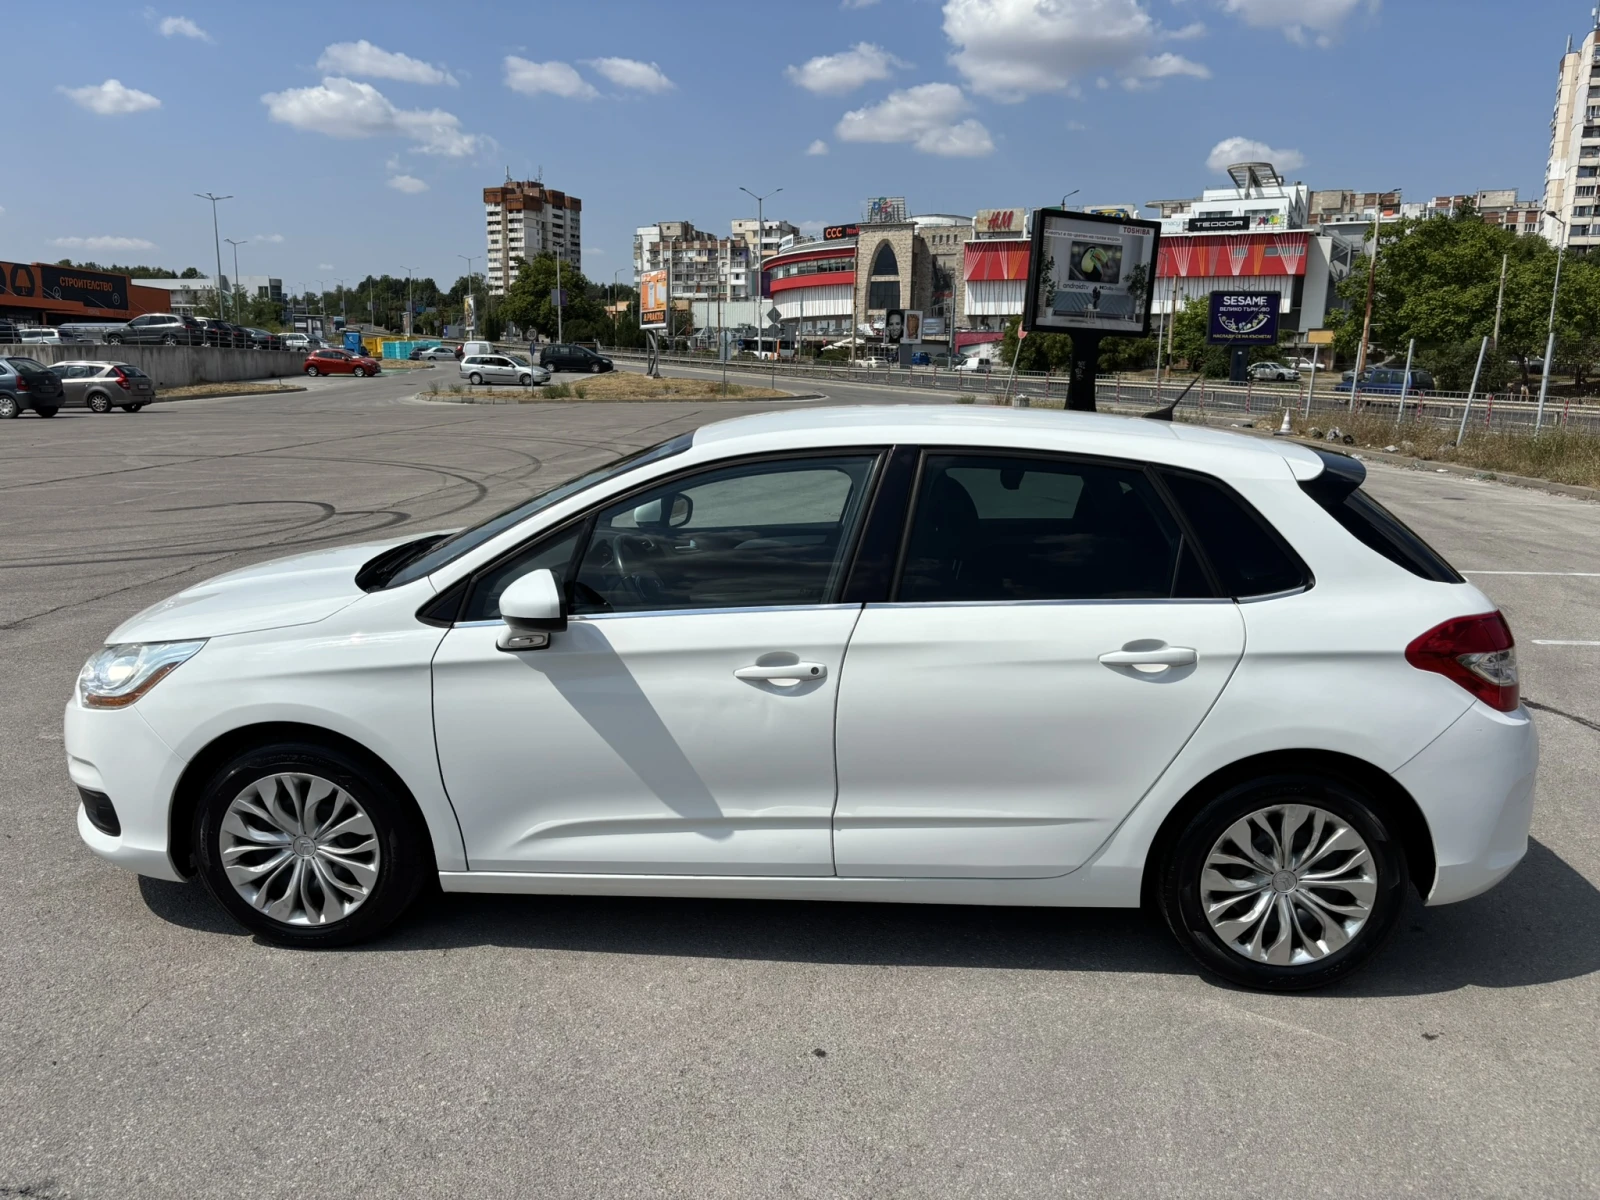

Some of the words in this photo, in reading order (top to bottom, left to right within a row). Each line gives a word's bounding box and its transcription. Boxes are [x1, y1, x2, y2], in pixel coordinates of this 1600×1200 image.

[825, 227, 843, 238] CCC
[1123, 226, 1151, 236] TOSHIBA
[59, 276, 113, 292] СТРОИТЕЛСТВО
[1223, 295, 1268, 305] SESAME
